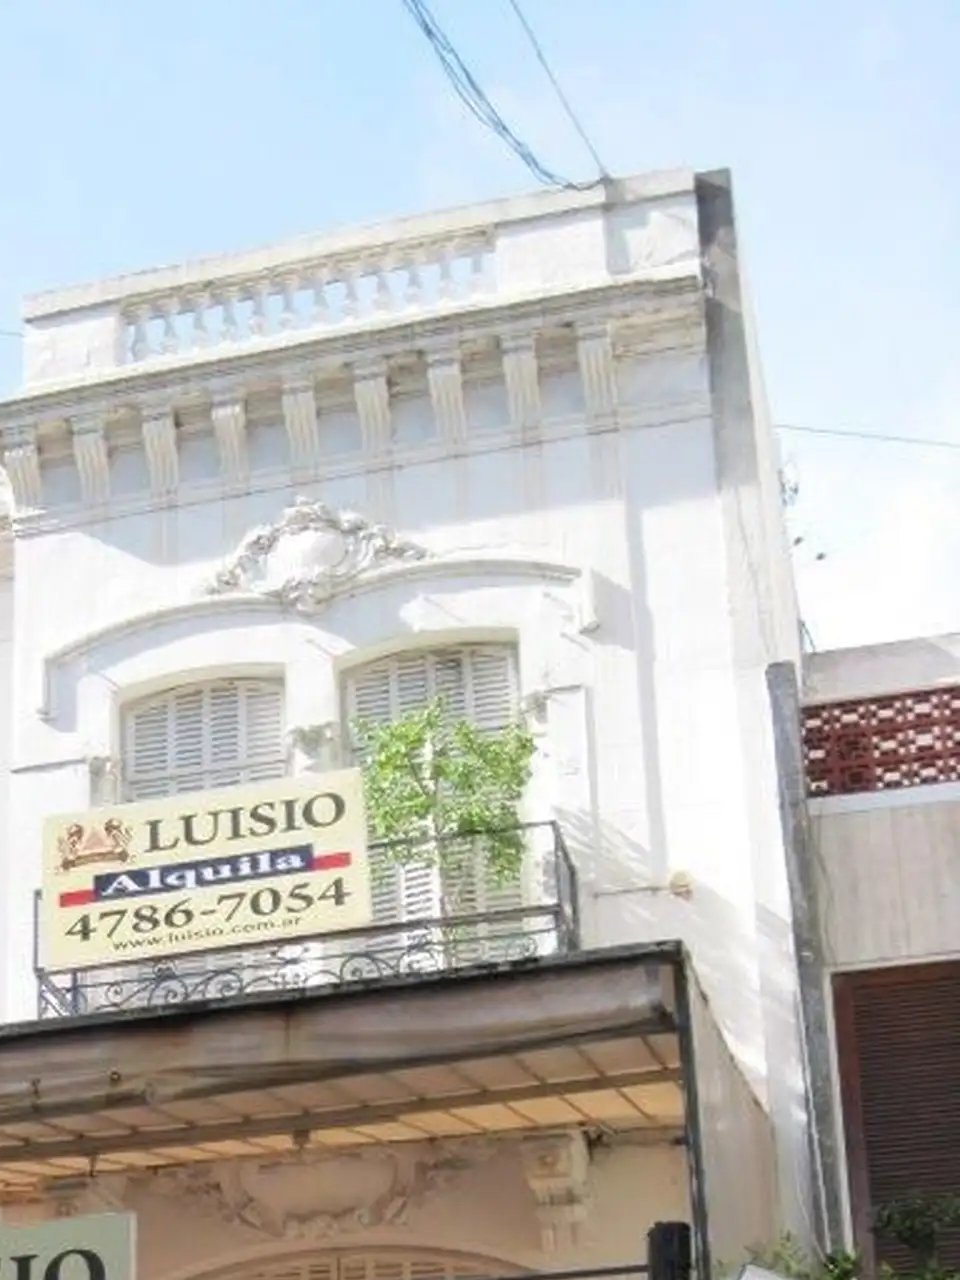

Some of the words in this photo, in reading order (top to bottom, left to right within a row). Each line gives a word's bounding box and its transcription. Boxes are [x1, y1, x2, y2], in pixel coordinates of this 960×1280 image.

[144, 792, 346, 853] LUISIO
[100, 852, 306, 897] Alquila
[65, 877, 352, 942] 4786-7054
[112, 917, 302, 953] www.luisio.com.ar
